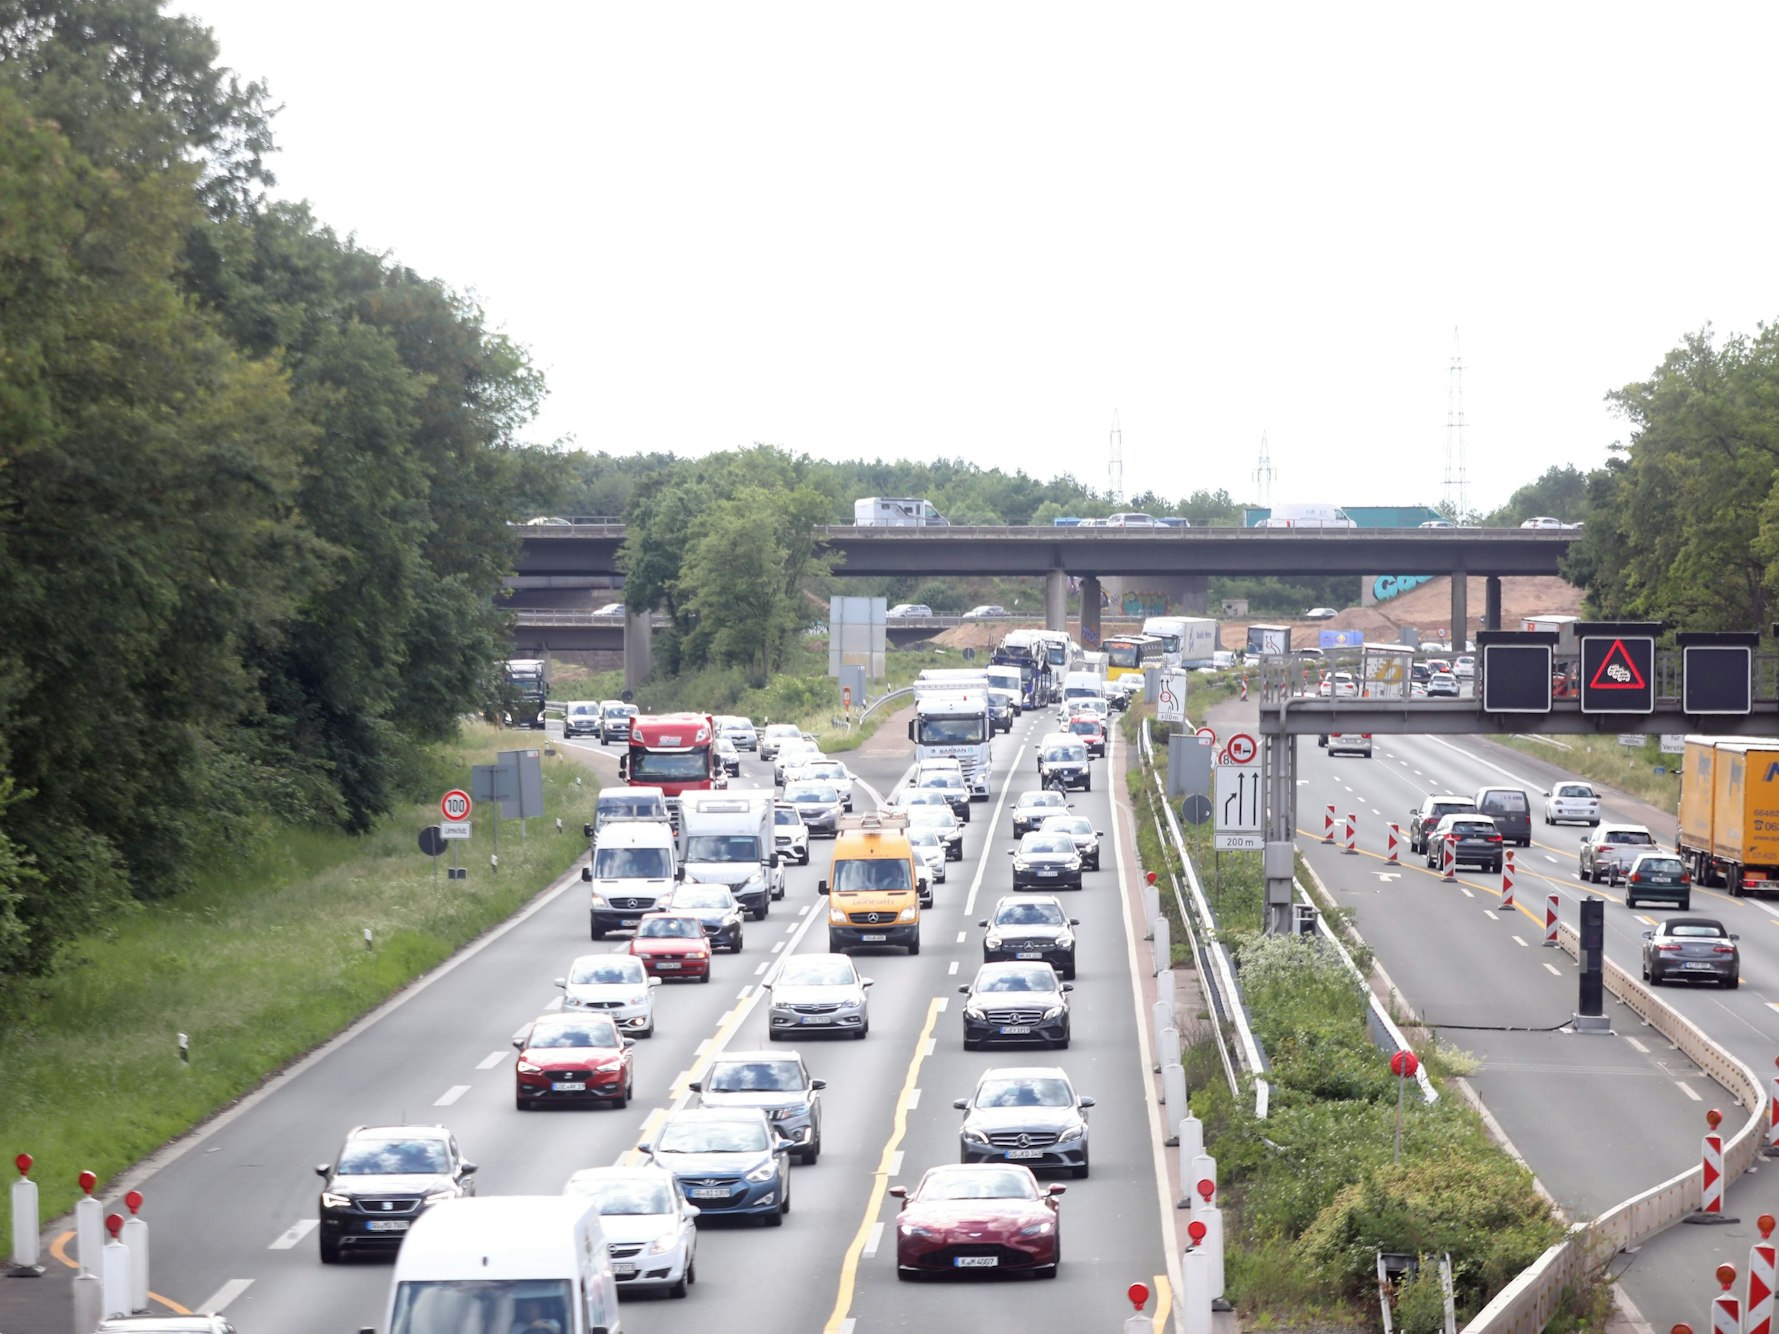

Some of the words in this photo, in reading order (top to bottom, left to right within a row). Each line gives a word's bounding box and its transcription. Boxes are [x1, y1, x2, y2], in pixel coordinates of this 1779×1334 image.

[447, 799, 465, 813] 100
[1226, 837, 1243, 847] 200
[1245, 839, 1254, 847] m
